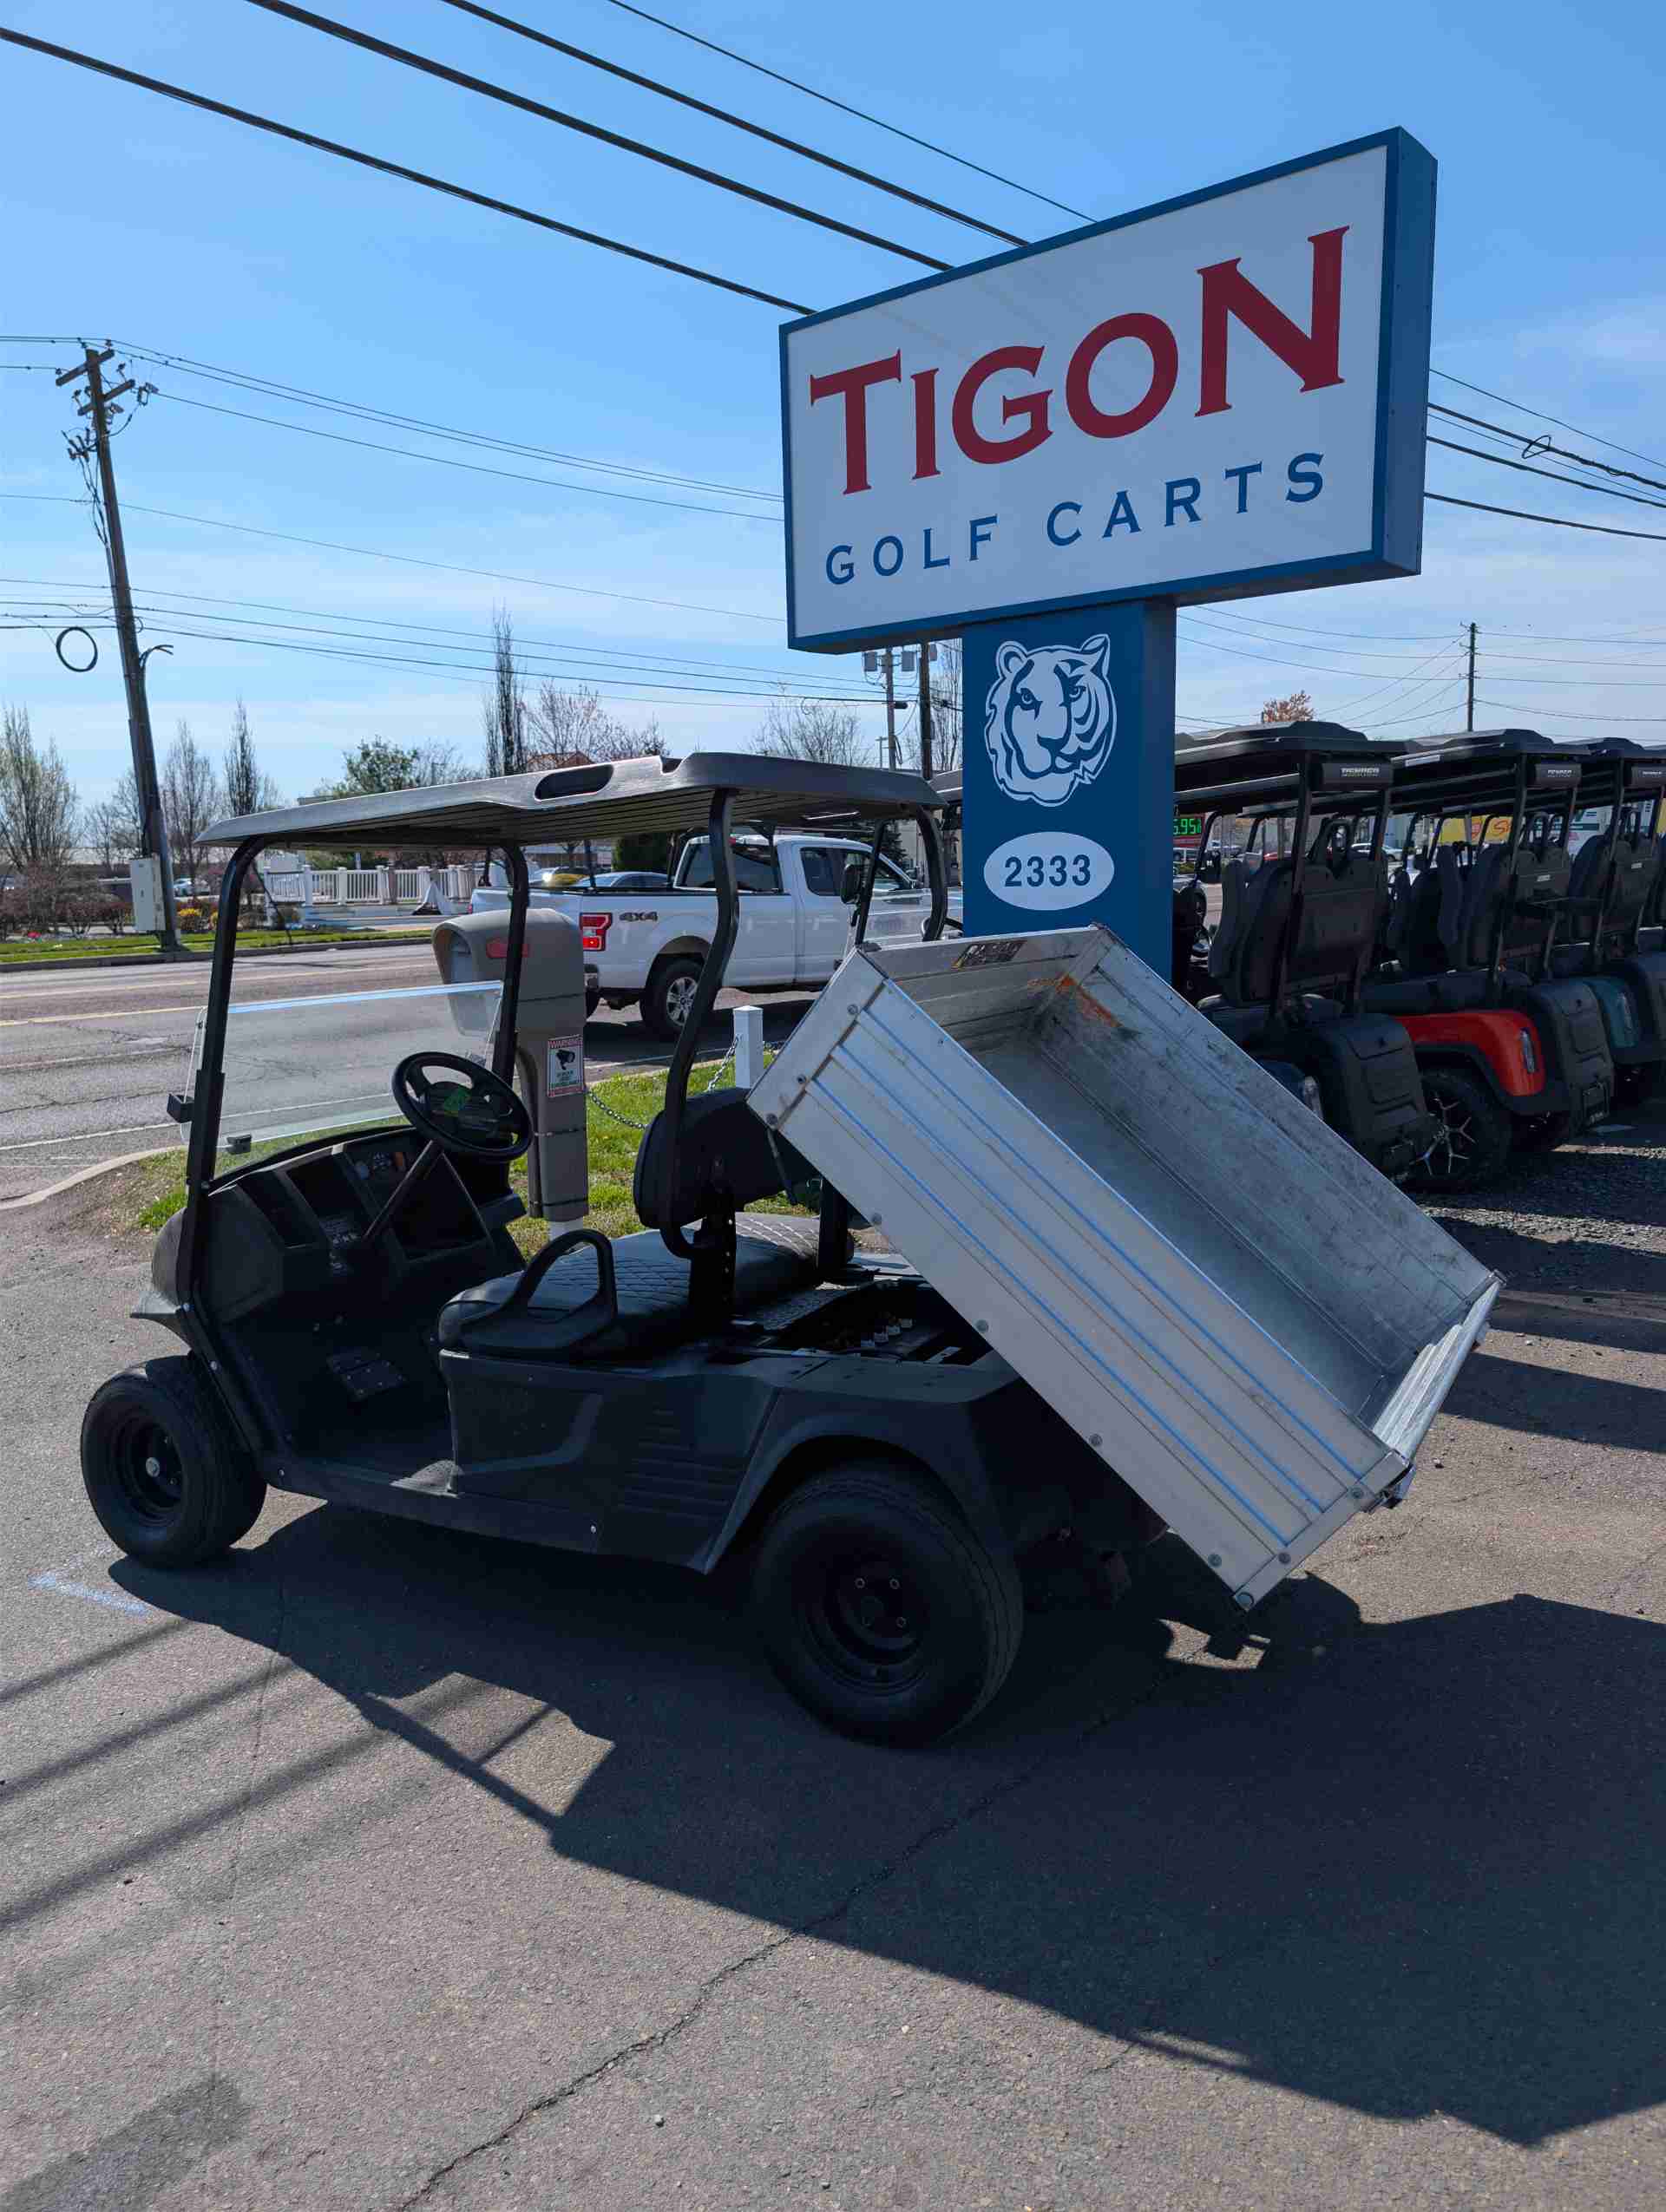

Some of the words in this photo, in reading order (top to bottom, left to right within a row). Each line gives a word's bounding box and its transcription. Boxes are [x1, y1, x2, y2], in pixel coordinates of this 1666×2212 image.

[810, 224, 1350, 495] TIGON
[825, 514, 997, 585] GOLF
[1046, 452, 1324, 546] CARTS
[1004, 854, 1091, 887] 2333
